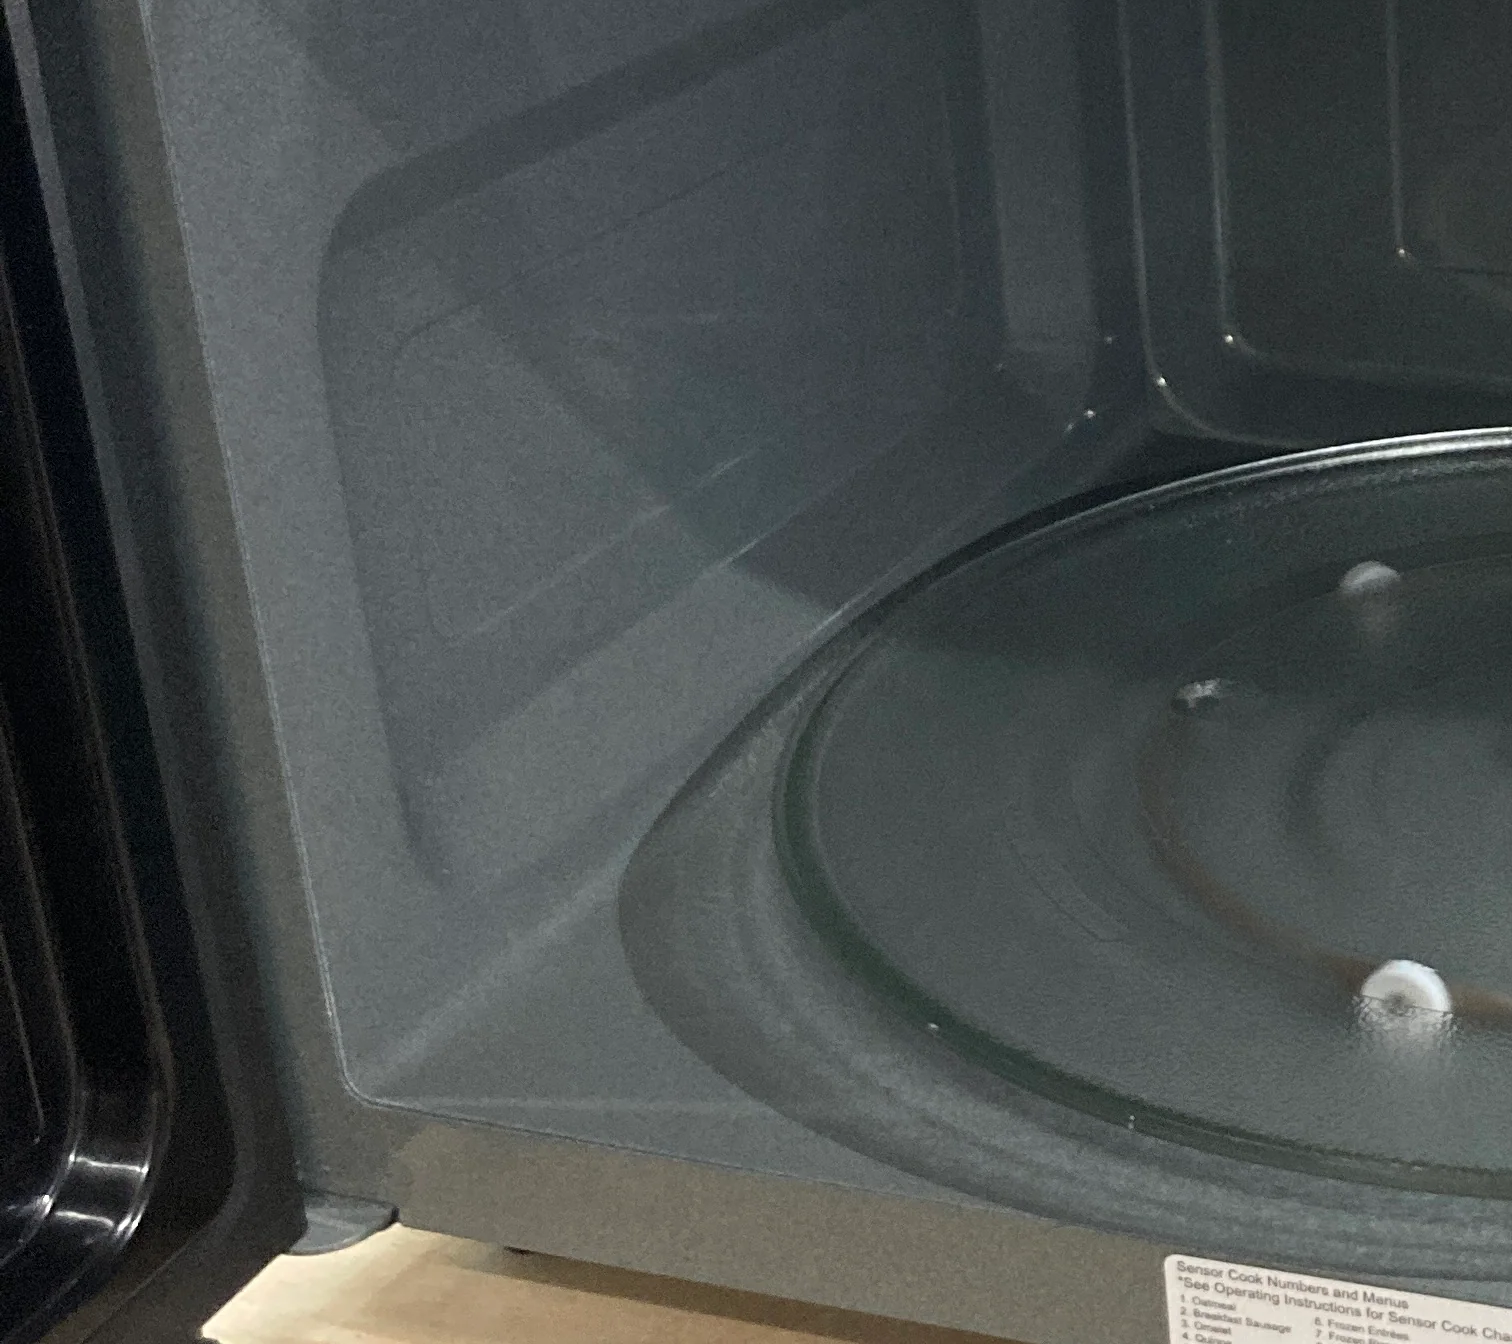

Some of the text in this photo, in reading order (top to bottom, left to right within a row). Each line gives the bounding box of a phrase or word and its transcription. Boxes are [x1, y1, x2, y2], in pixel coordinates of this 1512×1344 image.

[1177, 1260, 1409, 1309] Sensor Cook Numbers and Menus
[1214, 1282, 1280, 1306] Operating
[1284, 1294, 1362, 1318] Instructions
[1366, 1306, 1385, 1321] for
[1388, 1311, 1437, 1330] Sensor
[1441, 1319, 1478, 1338] Cook
